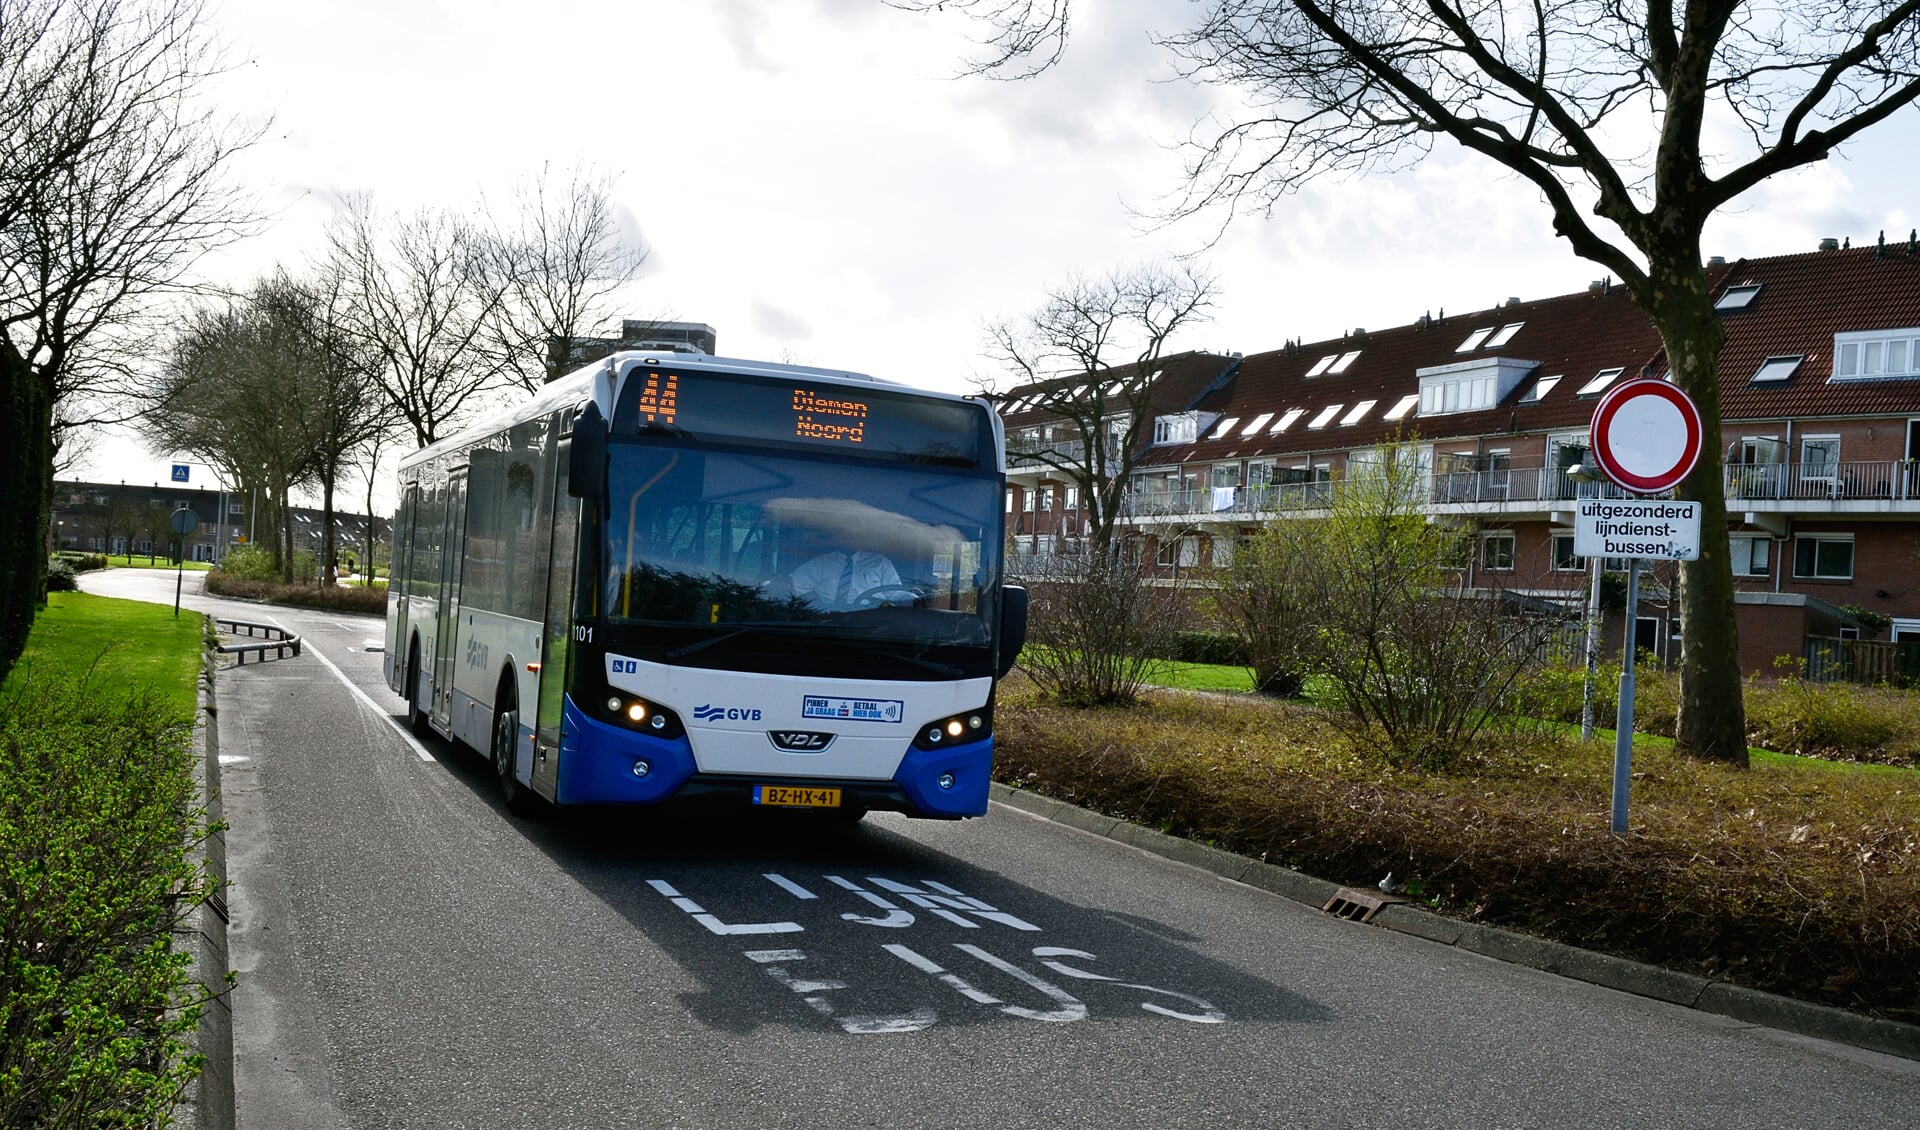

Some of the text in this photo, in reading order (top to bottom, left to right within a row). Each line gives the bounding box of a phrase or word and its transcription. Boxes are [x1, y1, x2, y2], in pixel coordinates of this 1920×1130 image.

[640, 373, 678, 424] 44
[792, 389, 867, 418] Diemen
[796, 415, 864, 442] Noord
[1582, 503, 1693, 519] uitgezonderd
[1595, 521, 1677, 537] lijndienst-
[1605, 539, 1666, 555] bussen
[728, 708, 762, 721] GVB
[853, 702, 878, 711] BETAAL
[778, 733, 823, 747] VDL
[768, 788, 834, 805] BZ-HX-41
[645, 873, 1043, 935] LIJN
